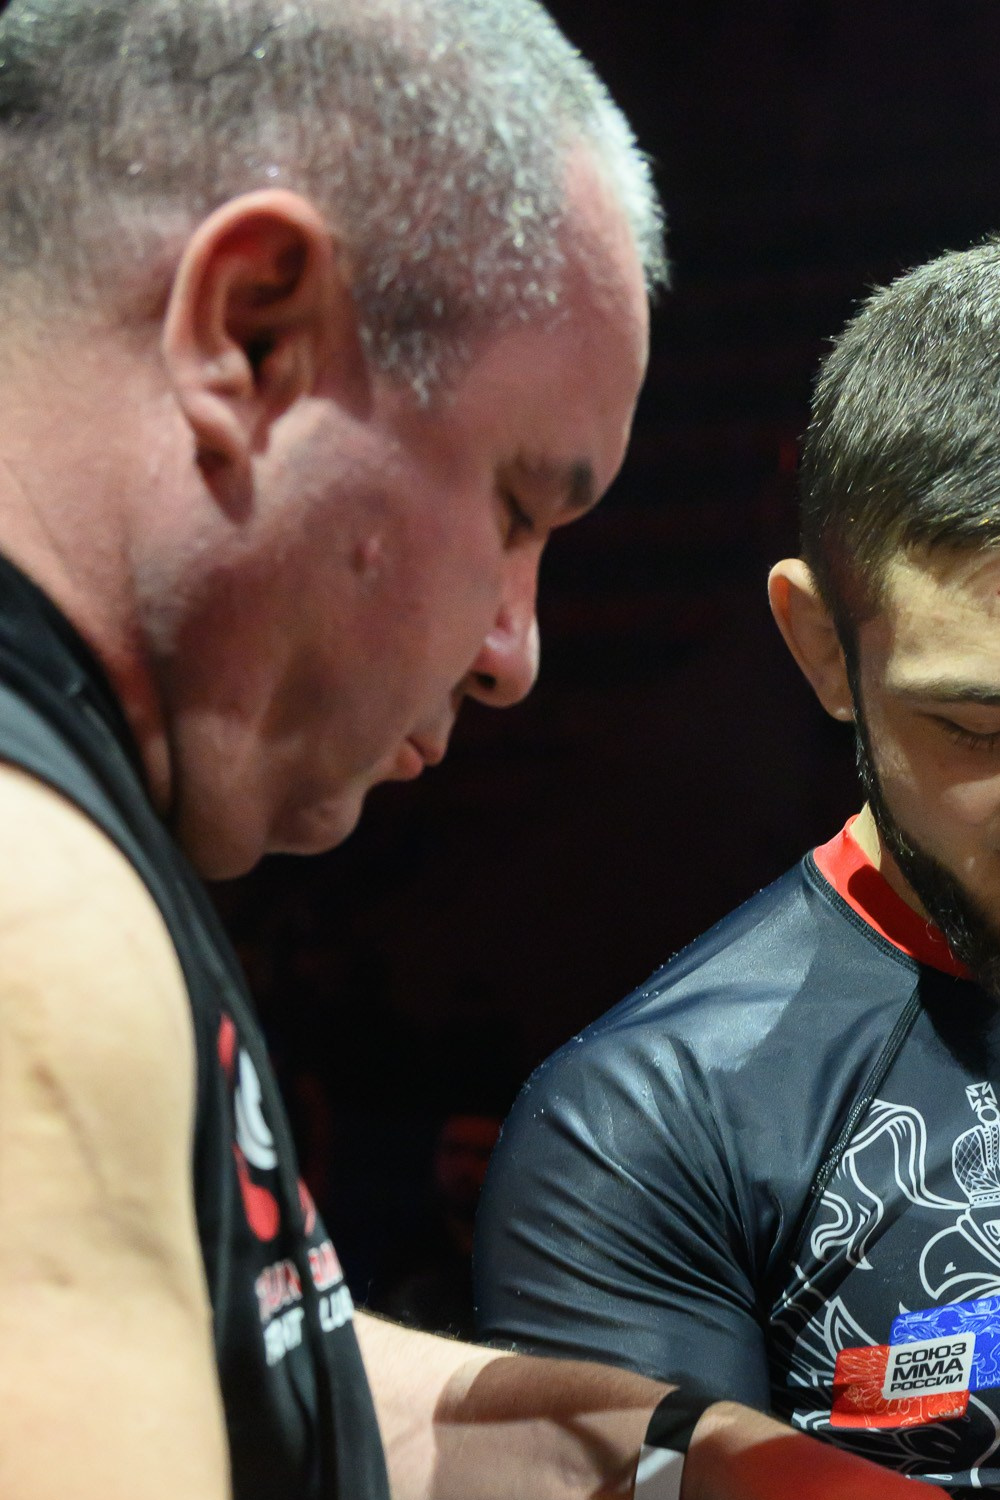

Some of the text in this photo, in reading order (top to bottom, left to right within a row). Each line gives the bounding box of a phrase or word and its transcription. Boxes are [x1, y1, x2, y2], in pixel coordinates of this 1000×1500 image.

[895, 1342, 967, 1366] СОЮЗ
[892, 1357, 964, 1382] ММА
[890, 1373, 963, 1392] РОССИИ
